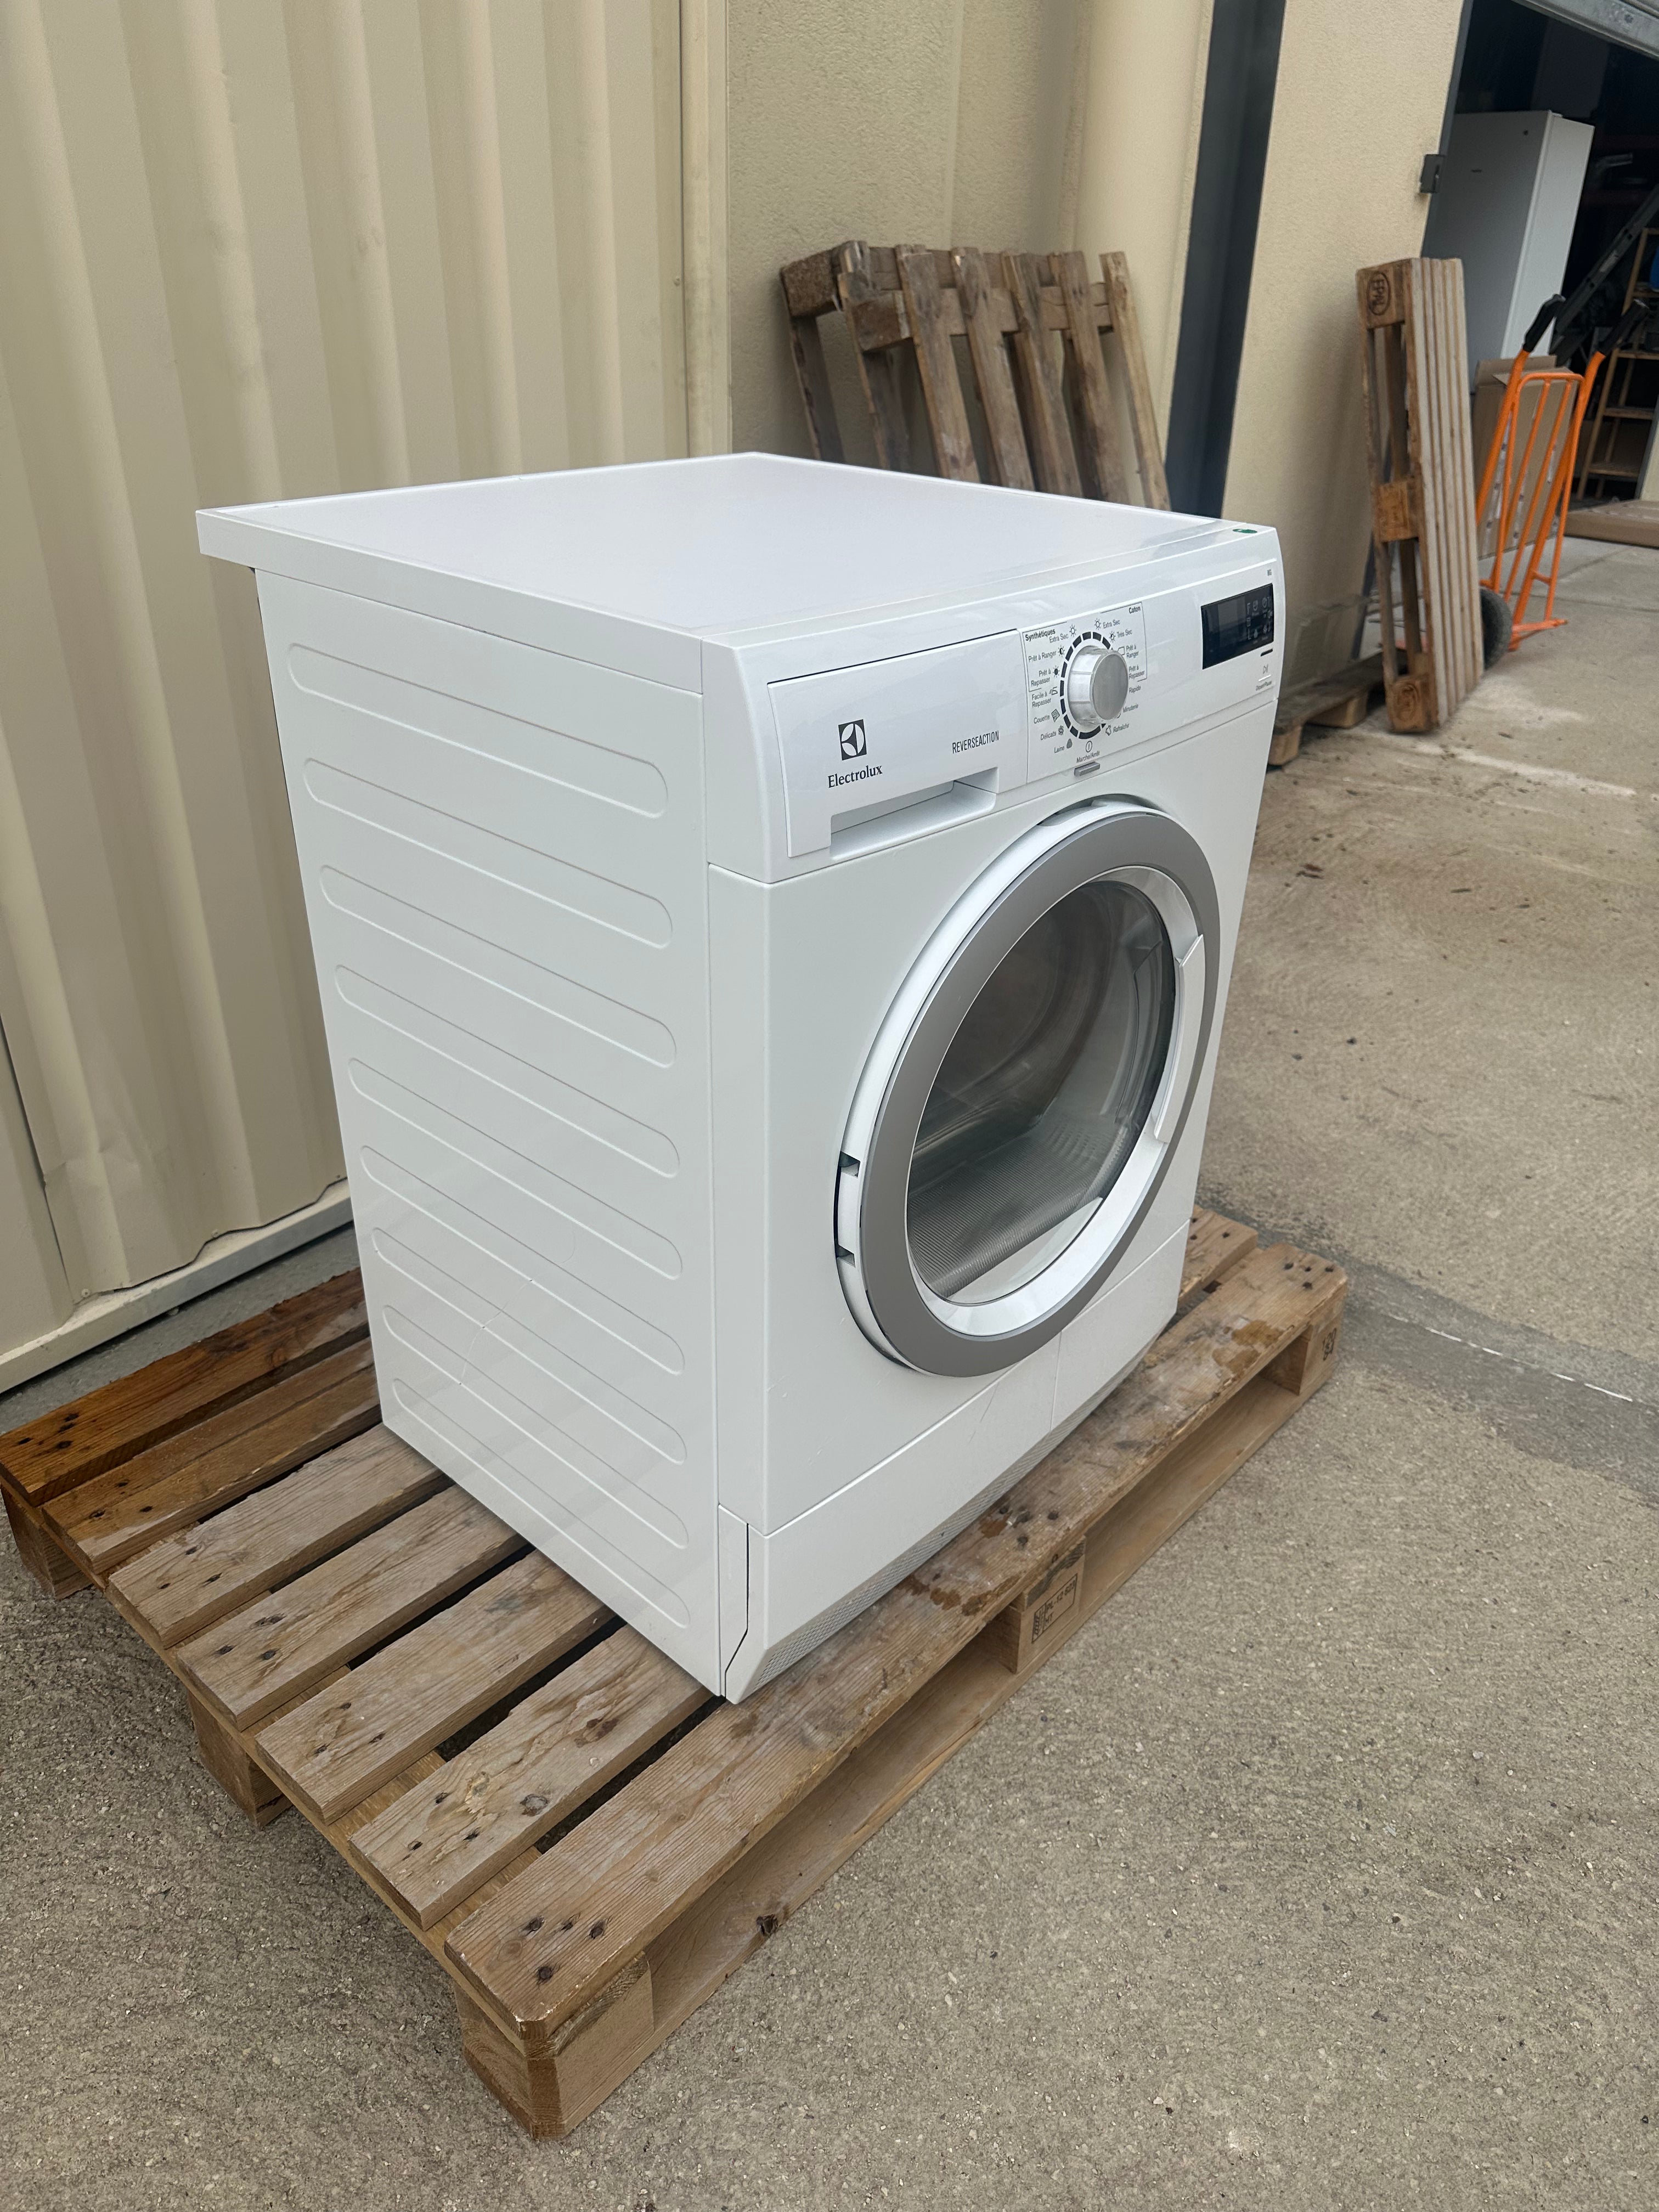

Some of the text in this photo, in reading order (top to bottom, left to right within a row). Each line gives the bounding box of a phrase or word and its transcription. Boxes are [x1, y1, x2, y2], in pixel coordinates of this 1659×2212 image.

[1103, 619, 1121, 629] Extra Sec
[1025, 628, 1056, 642] Synthétiques
[1049, 635, 1059, 643] Extra
[1041, 651, 1057, 660] Ranger
[1126, 651, 1139, 659] Ranger
[1031, 677, 1051, 687] Repasser
[1031, 692, 1043, 701] Facile
[1032, 698, 1052, 708] Repasser
[952, 730, 999, 754] REVERSEACTION
[828, 765, 883, 788] Electrolux
